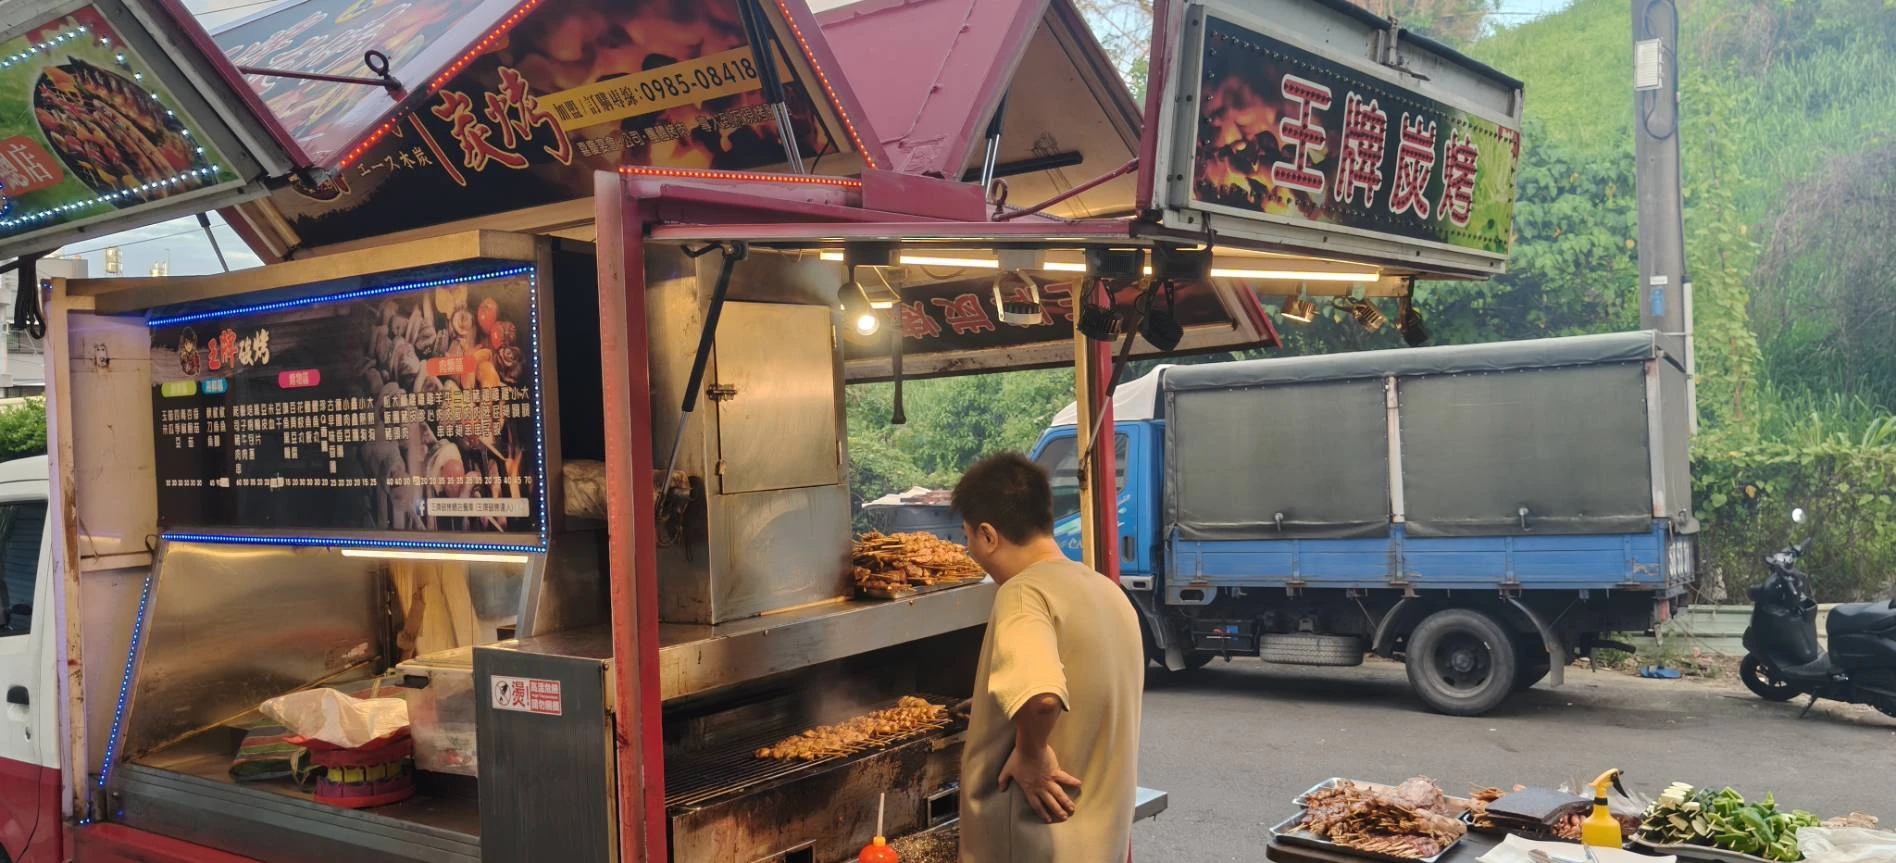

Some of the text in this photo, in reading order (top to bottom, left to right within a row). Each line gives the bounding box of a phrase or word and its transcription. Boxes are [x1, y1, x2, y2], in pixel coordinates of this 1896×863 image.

[358, 146, 433, 177] エース木炭
[1271, 73, 1481, 228] 王牌炭烤
[512, 680, 525, 707] 燙
